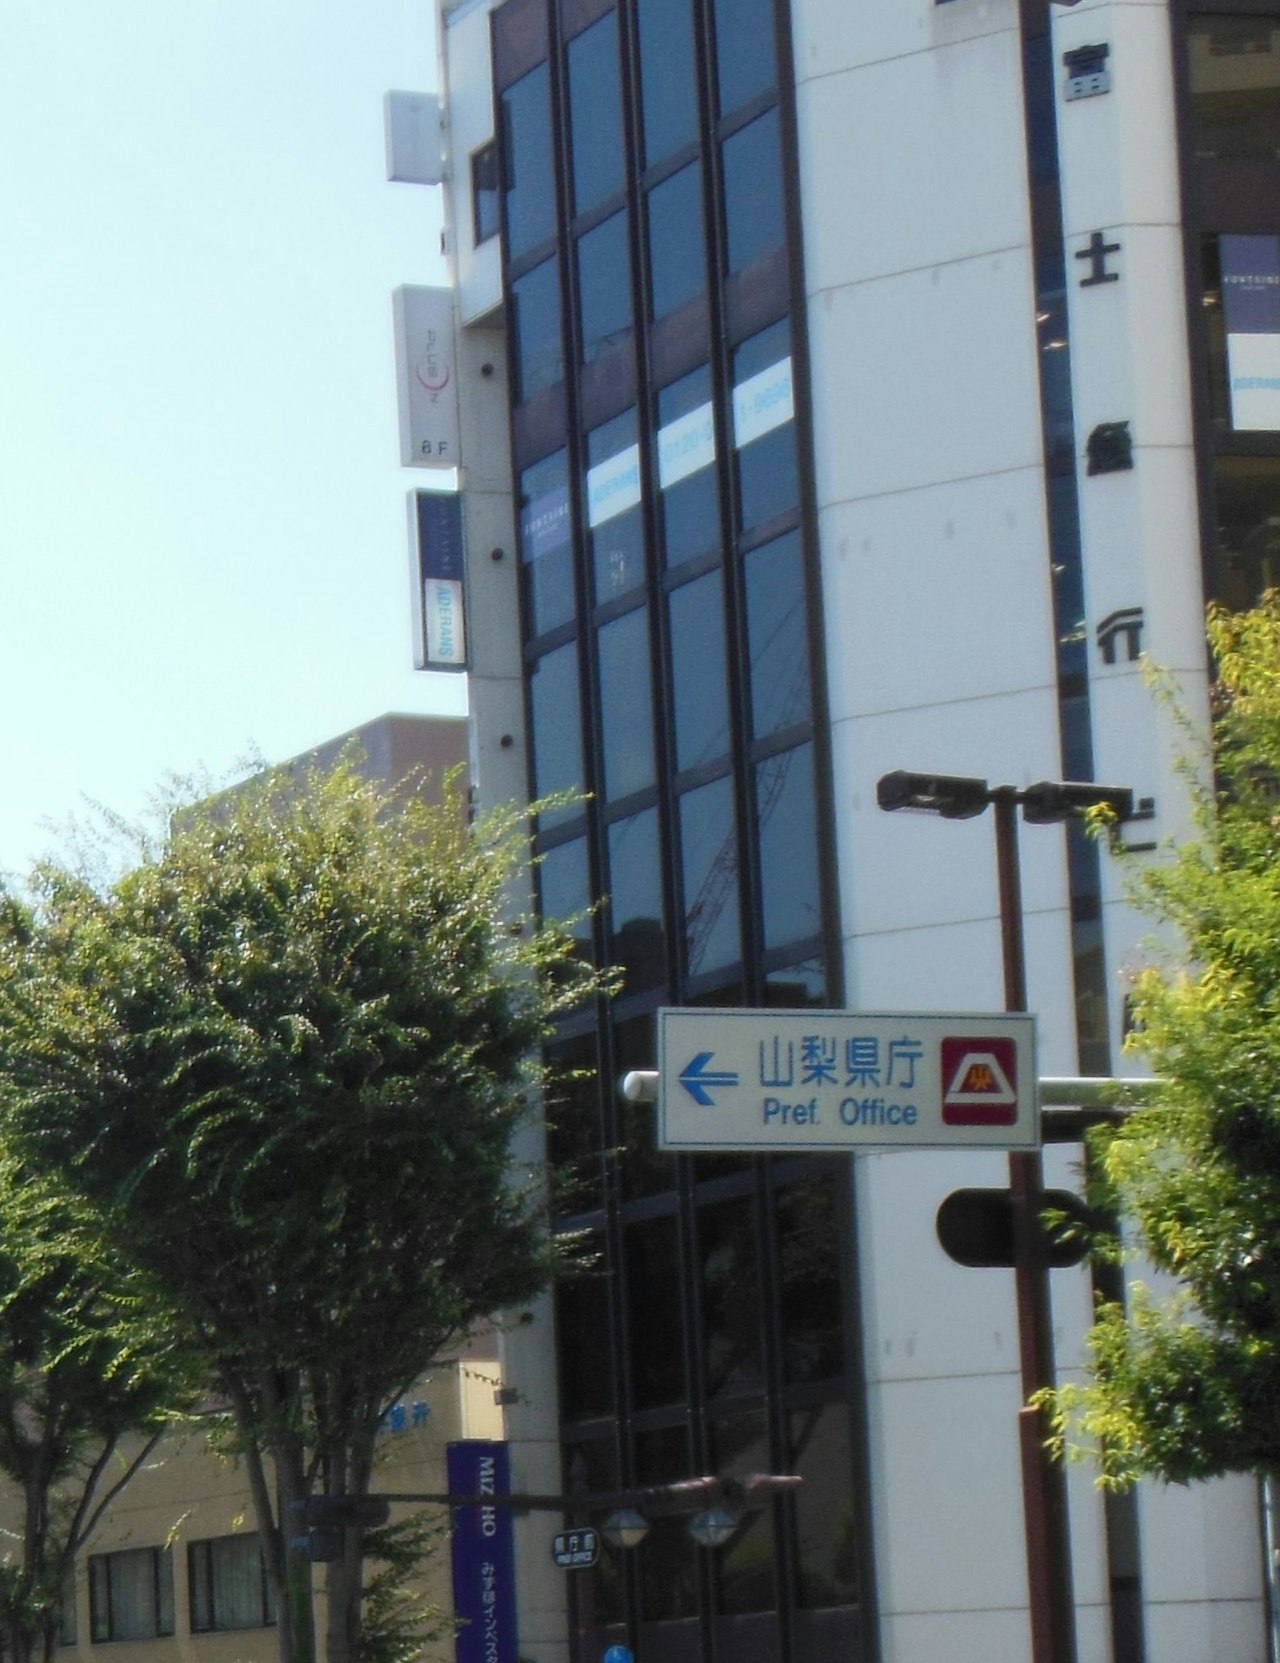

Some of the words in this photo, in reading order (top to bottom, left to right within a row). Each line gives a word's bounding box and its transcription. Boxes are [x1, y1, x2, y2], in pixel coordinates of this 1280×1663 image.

[759, 1035, 924, 1088] 山梨県庁
[763, 1099, 821, 1125] Pref.
[840, 1098, 917, 1125] Office
[480, 1457, 496, 1537] MIZHO
